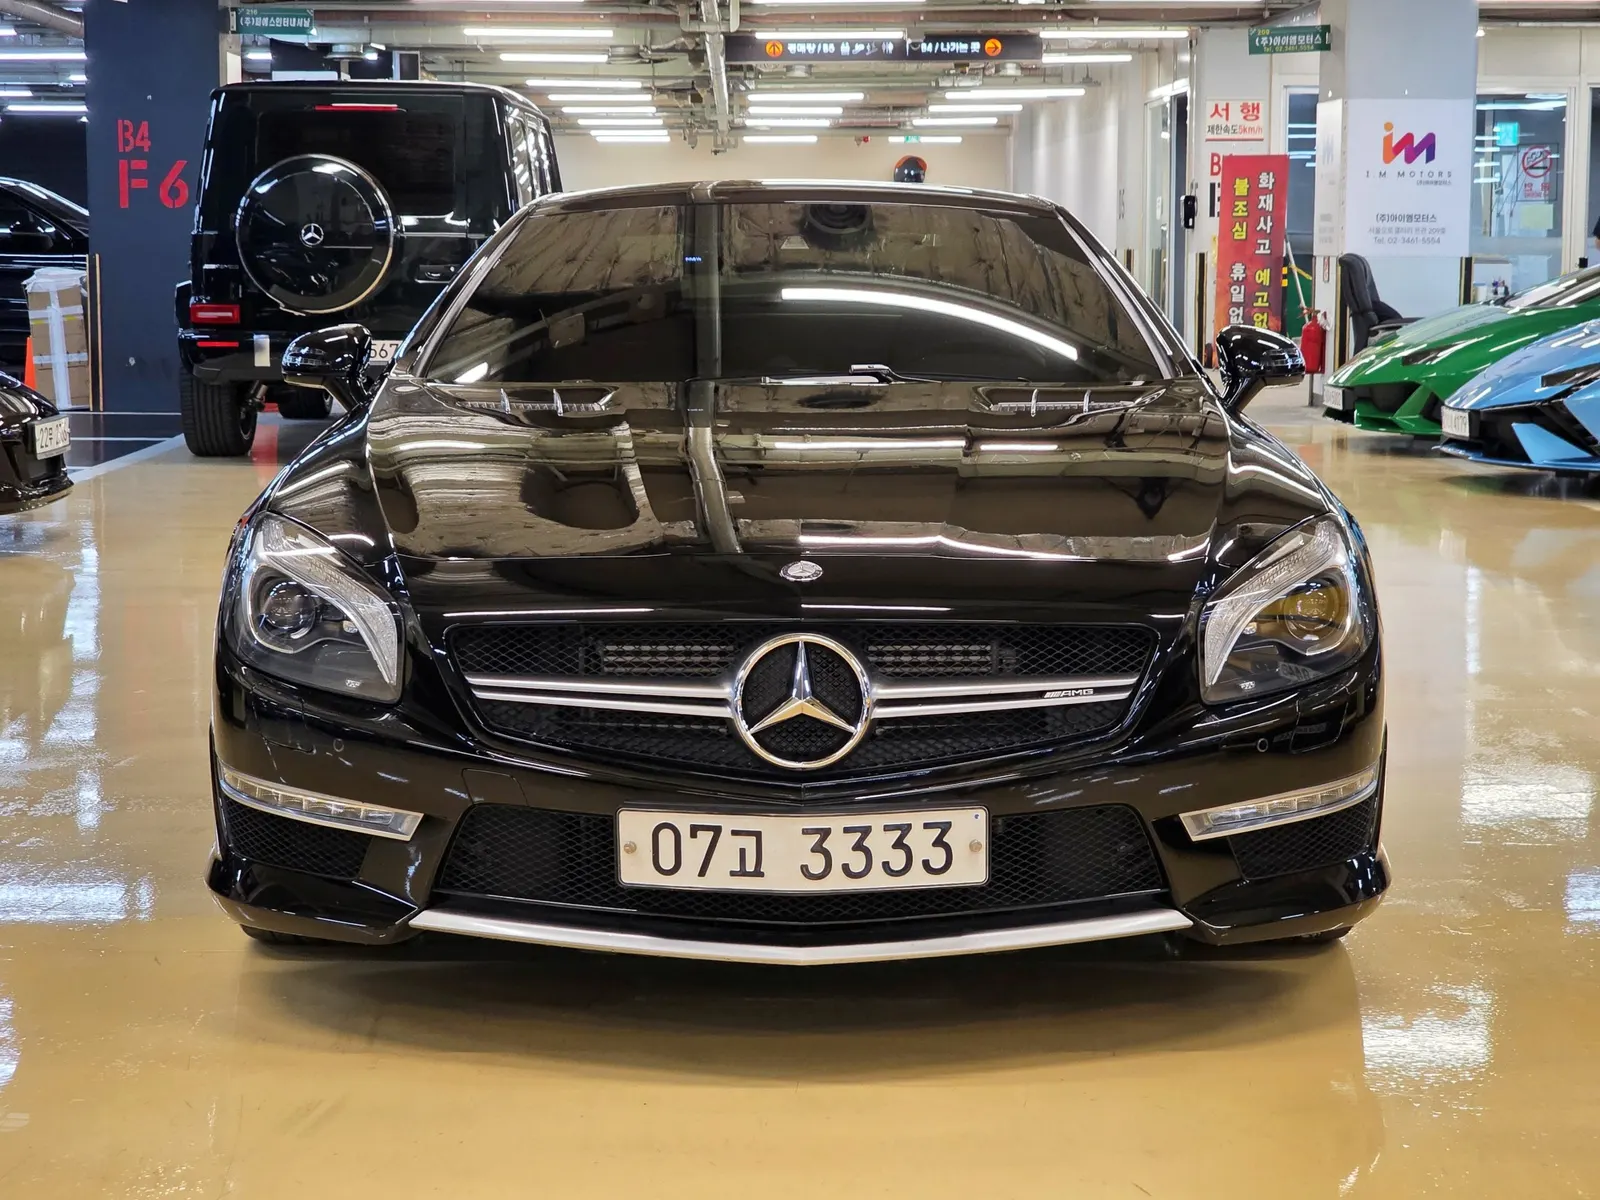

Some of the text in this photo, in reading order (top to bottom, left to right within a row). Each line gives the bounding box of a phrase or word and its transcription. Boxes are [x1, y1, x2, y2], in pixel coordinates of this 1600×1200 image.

[1255, 33, 1322, 47] (주)아이엠모터스
[117, 119, 151, 152] B4
[1232, 178, 1249, 239] 불조심
[1255, 172, 1274, 254] 화재사고
[1376, 213, 1437, 223] (주)아이엠모터스
[1060, 689, 1094, 697] AMG
[652, 821, 953, 880] 07고 3333
